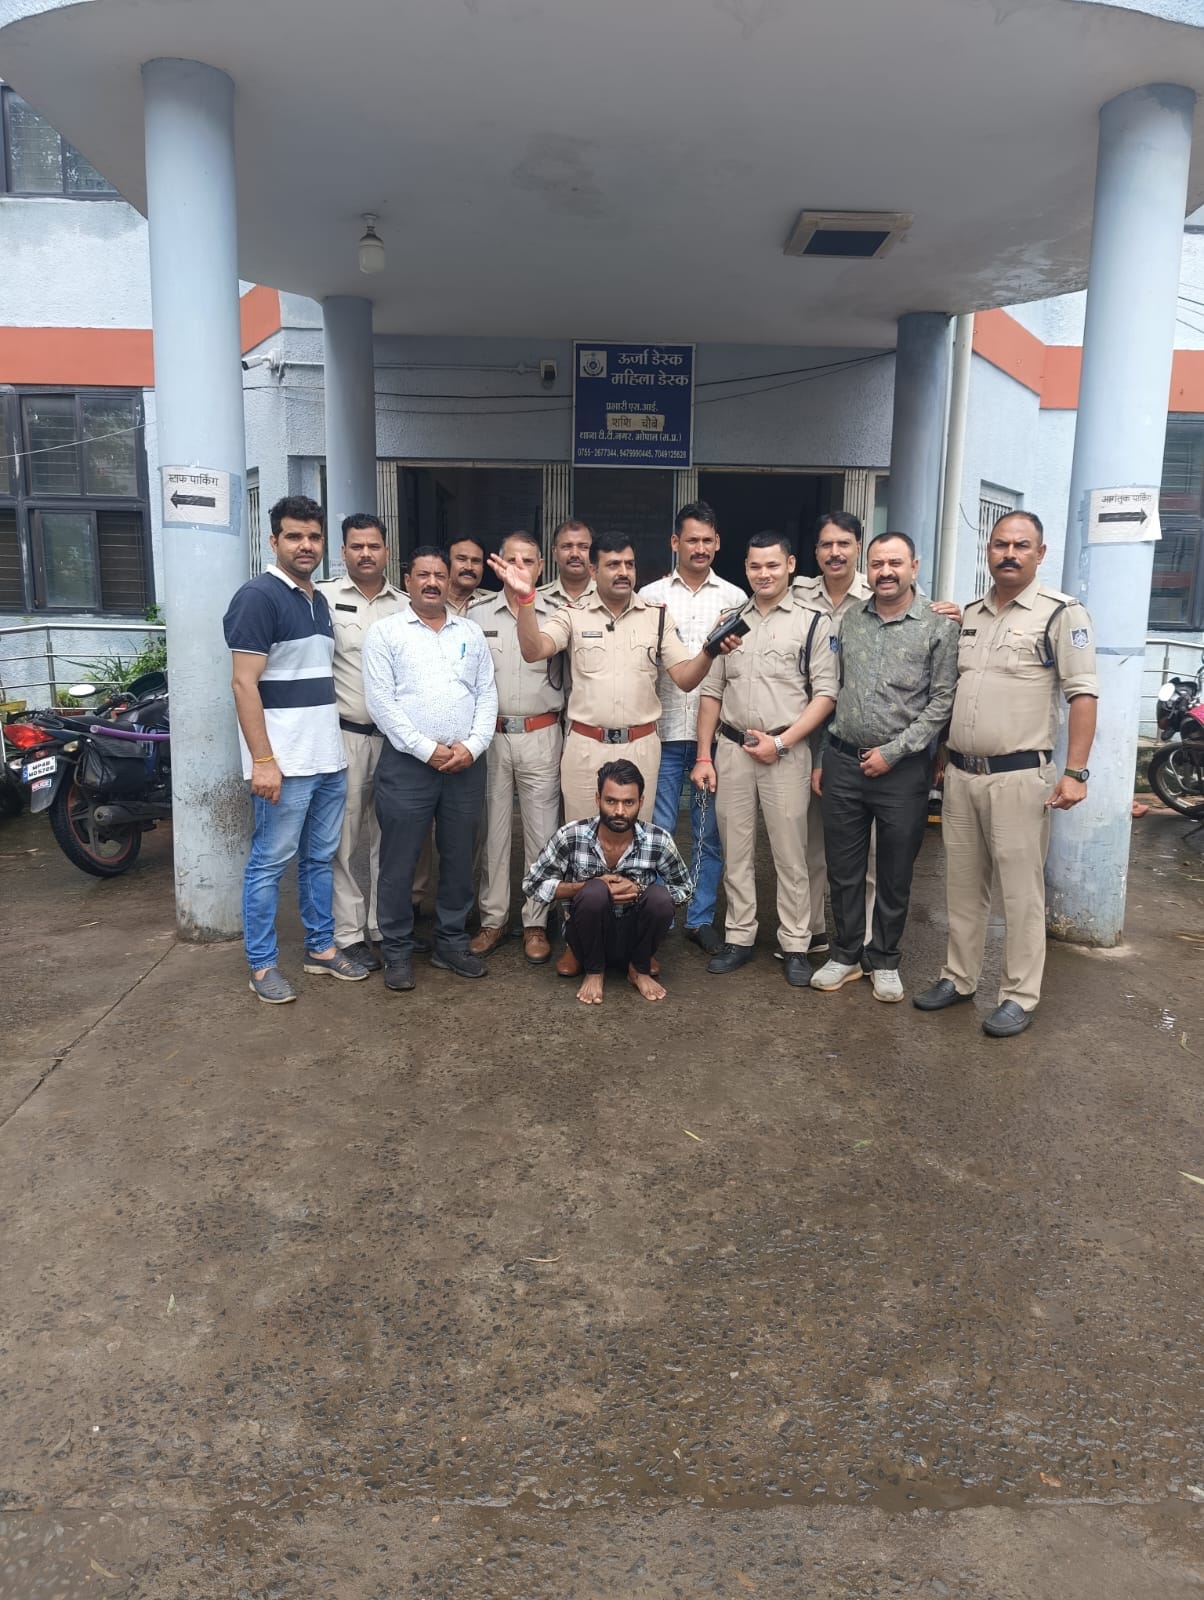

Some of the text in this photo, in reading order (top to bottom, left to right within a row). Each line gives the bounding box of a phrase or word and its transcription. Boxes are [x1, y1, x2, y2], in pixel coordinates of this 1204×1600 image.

[618, 349, 684, 366] ऊर्जा डेस्क
[610, 369, 690, 386] महिला डेस्क
[168, 474, 187, 484] स्टाफ
